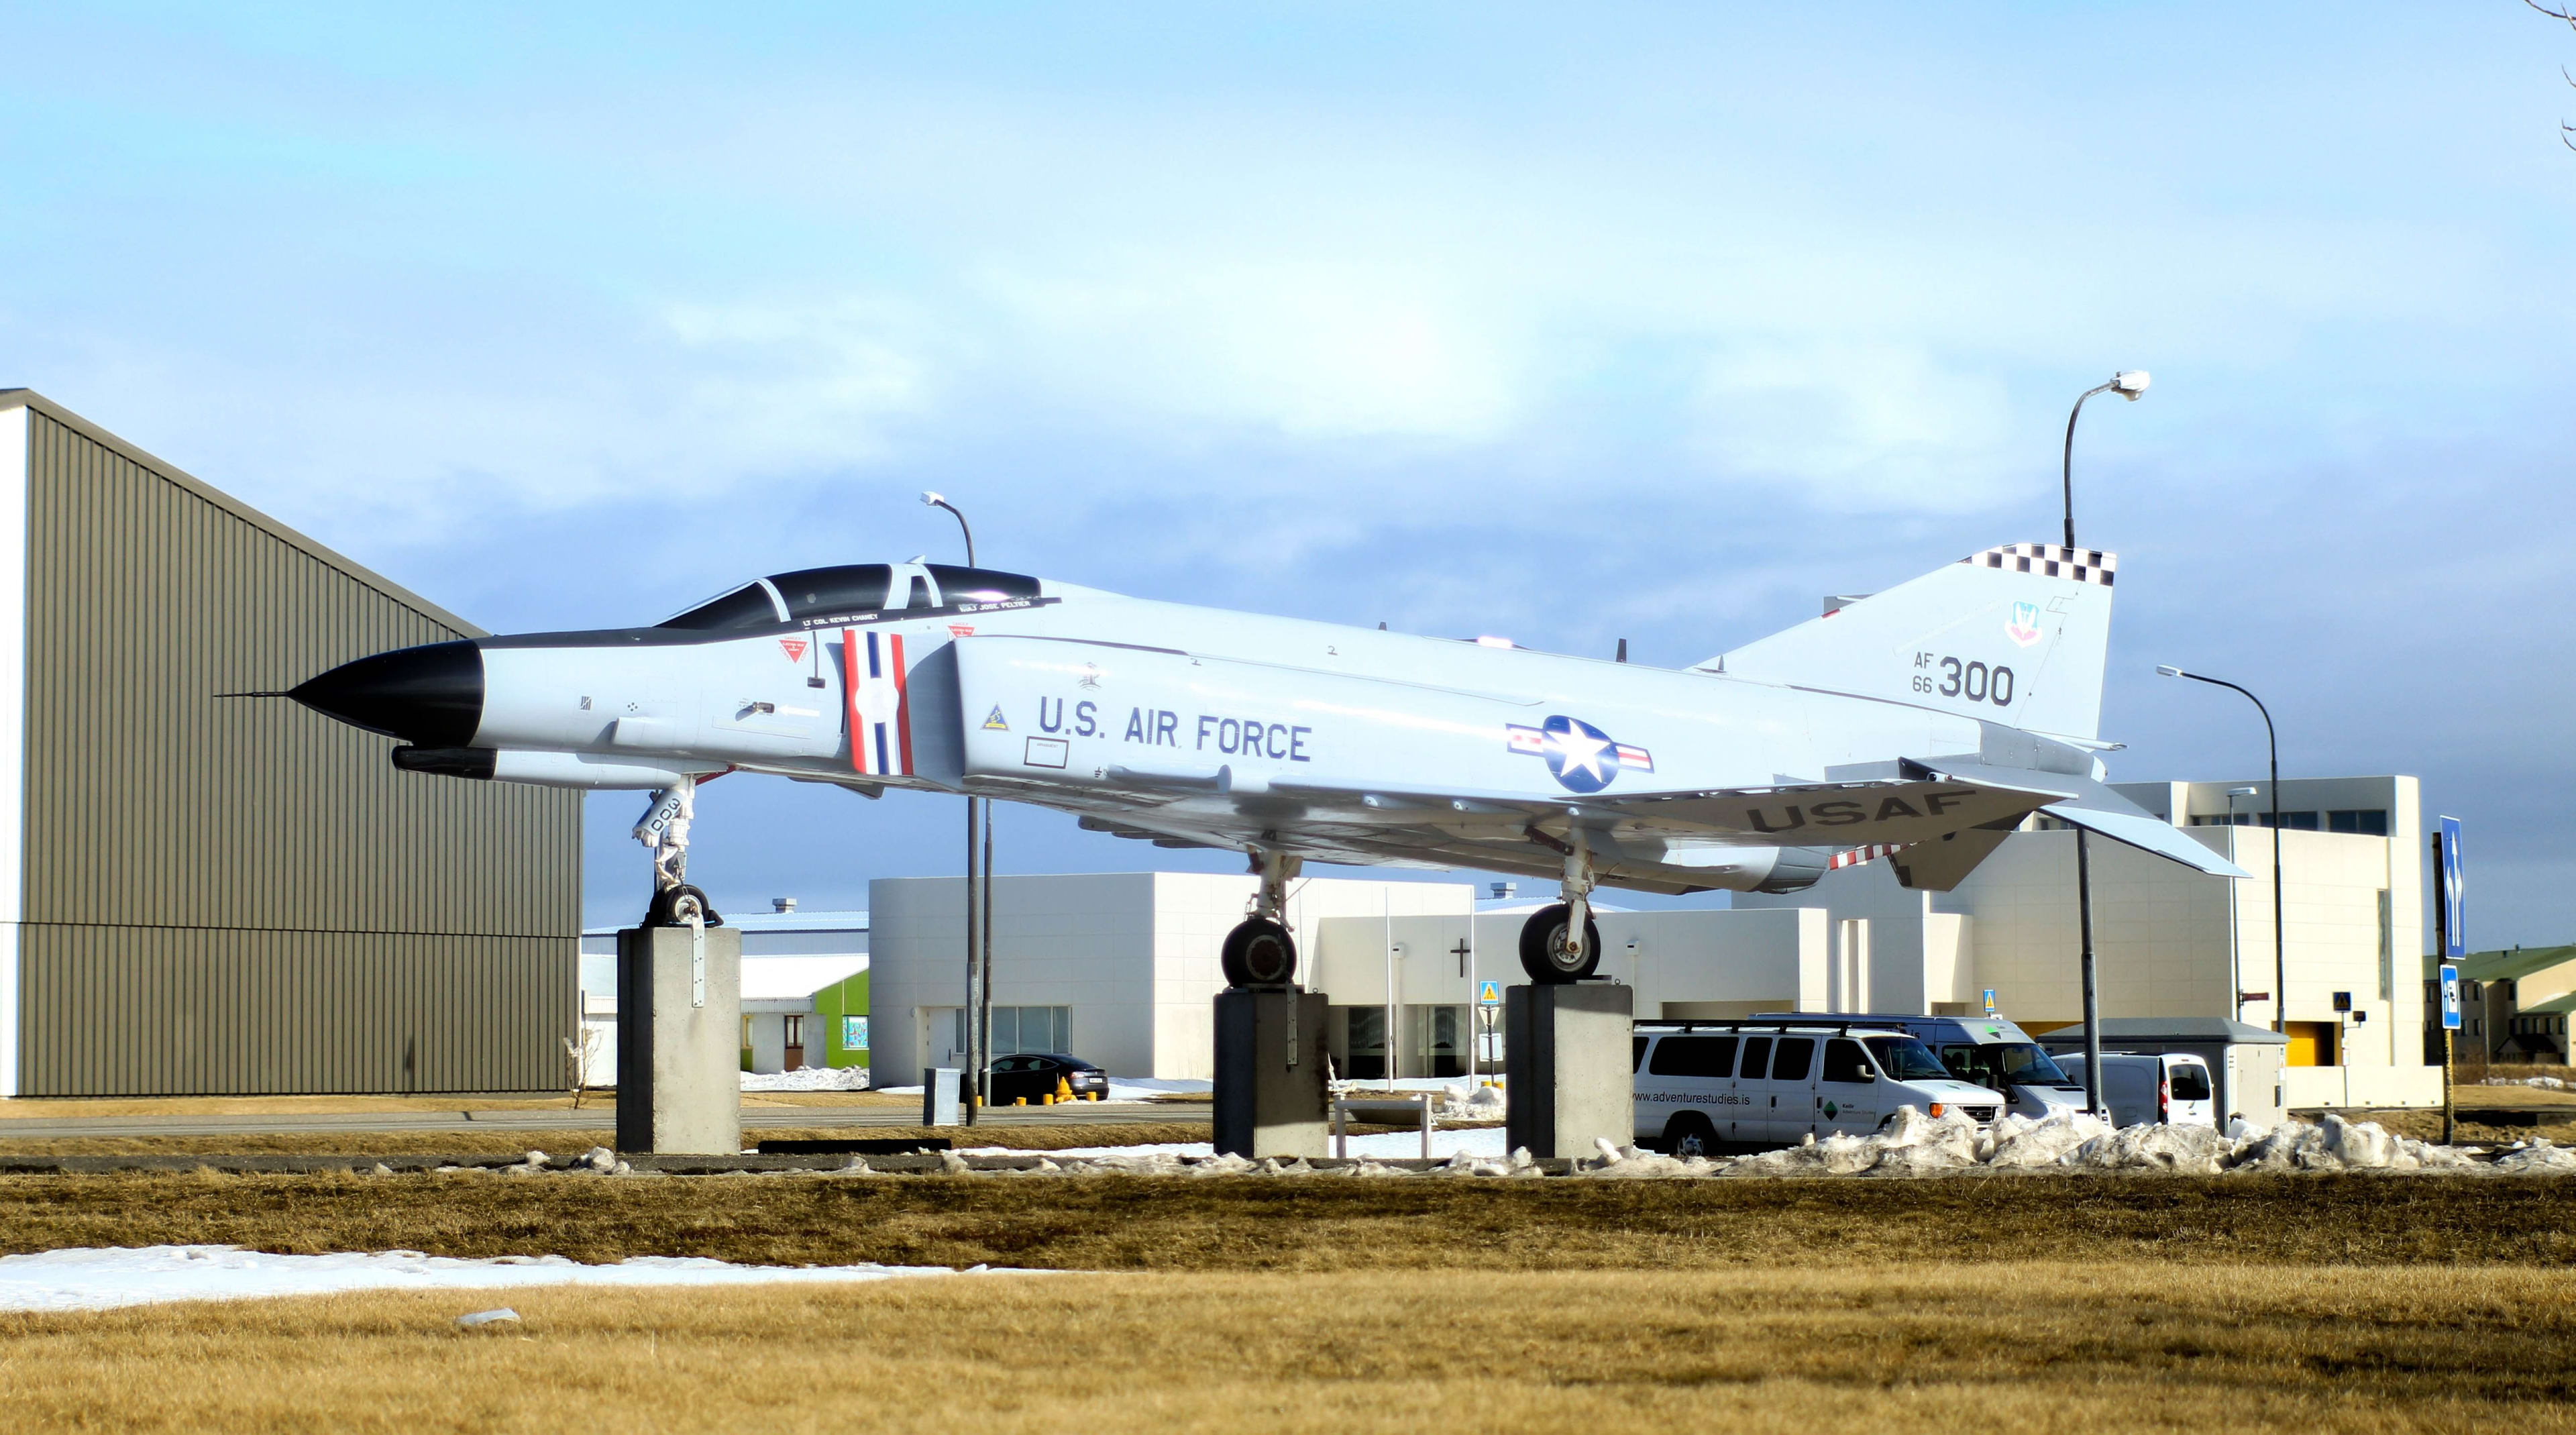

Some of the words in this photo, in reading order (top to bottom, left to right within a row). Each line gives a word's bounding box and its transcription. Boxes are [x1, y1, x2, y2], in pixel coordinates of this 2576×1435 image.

[1001, 600, 1031, 608] PELTIER
[852, 613, 878, 621] CHANEY
[1914, 651, 1934, 669] AF
[1913, 675, 1933, 694] 66
[1938, 656, 2014, 706] 300
[1040, 696, 1105, 739] U.S.
[1124, 706, 1179, 747] AIR
[1197, 714, 1312, 762] FORCE
[1746, 790, 1976, 833] USAF
[1633, 1090, 1750, 1106] ww.adventurestudies.is
